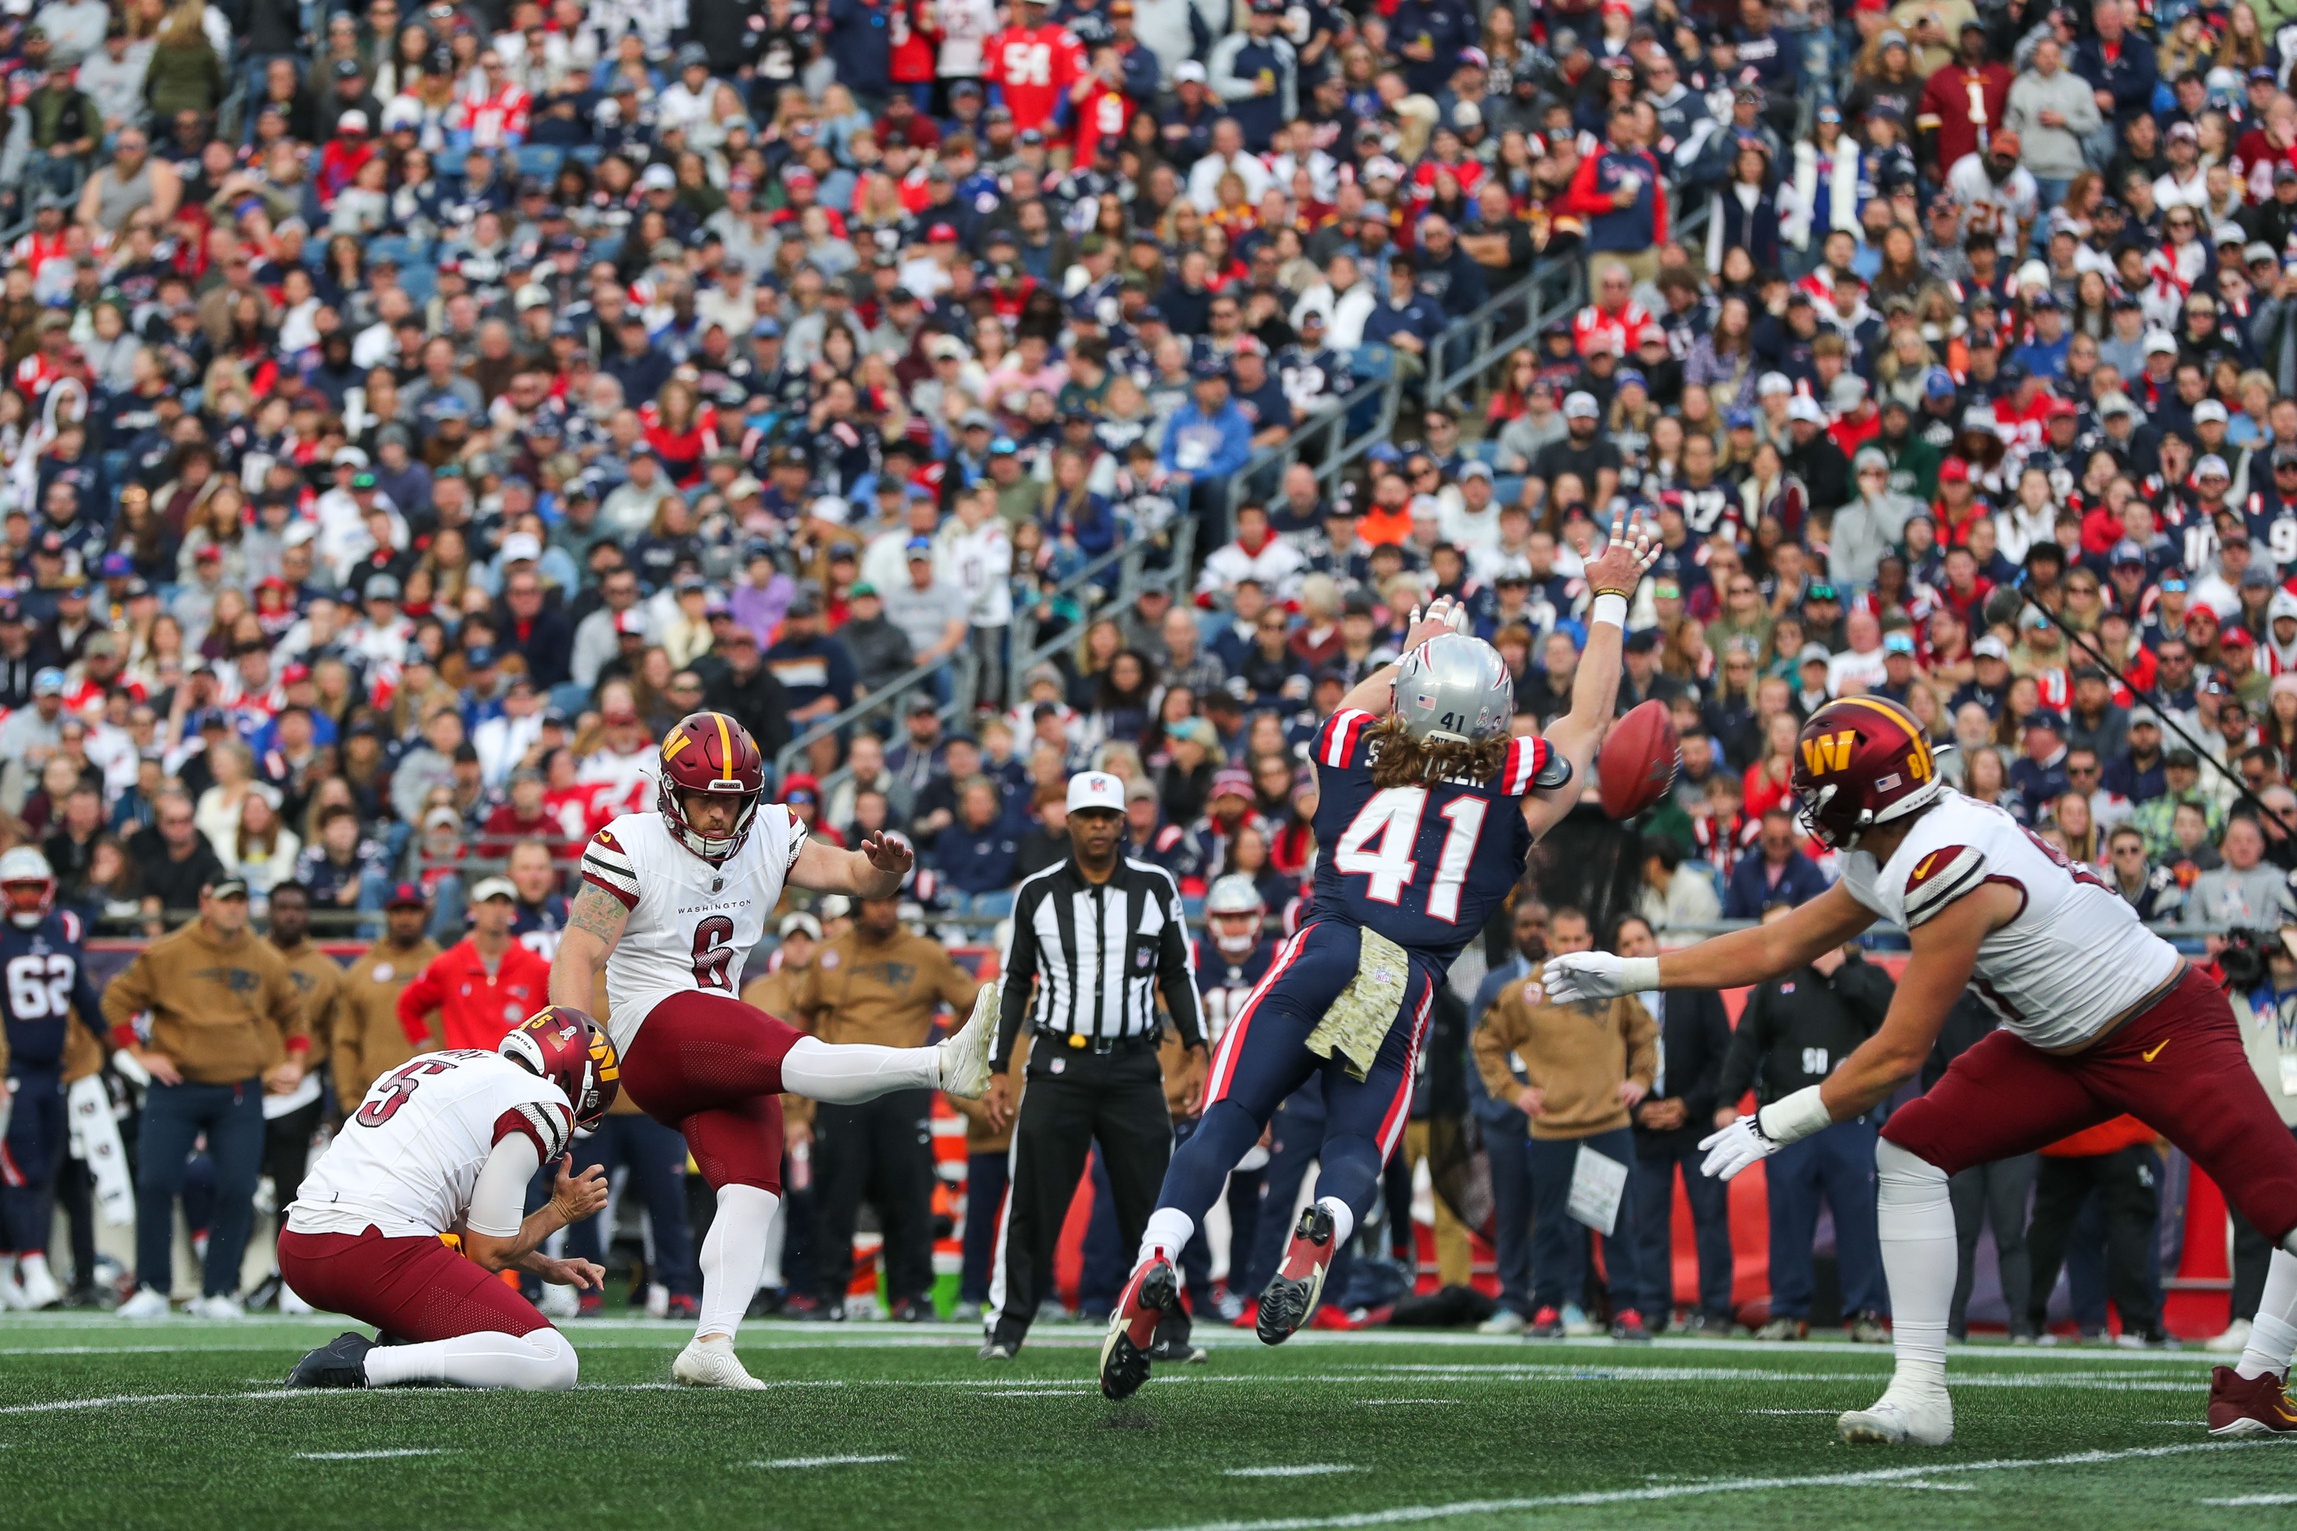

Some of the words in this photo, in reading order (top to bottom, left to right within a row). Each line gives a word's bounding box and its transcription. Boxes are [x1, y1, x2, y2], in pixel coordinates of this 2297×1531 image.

[1966, 80, 1988, 124] 1
[1440, 711, 1466, 733] 41
[1332, 781, 1490, 926] 41
[678, 899, 752, 915] WASHINGTON
[6, 954, 76, 1020] 62
[691, 915, 735, 993] 6
[356, 1059, 459, 1128] 5
